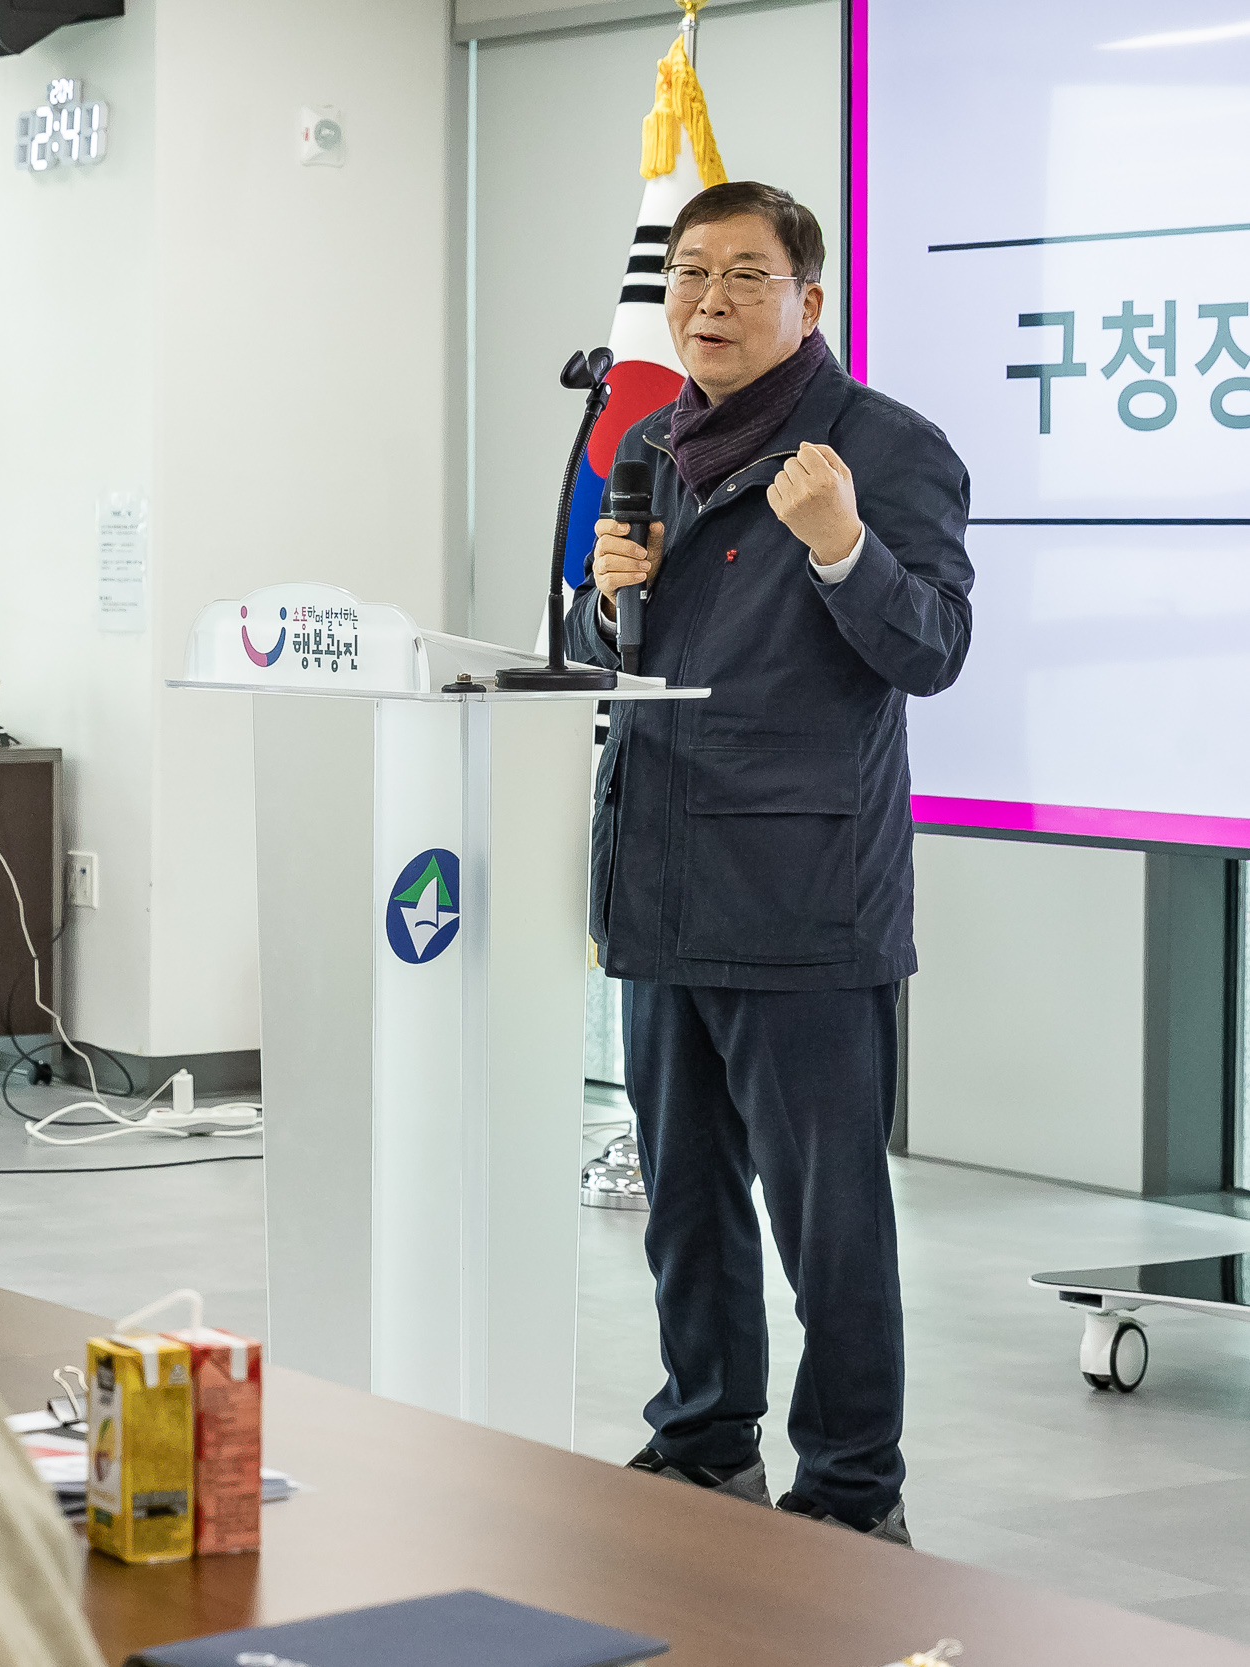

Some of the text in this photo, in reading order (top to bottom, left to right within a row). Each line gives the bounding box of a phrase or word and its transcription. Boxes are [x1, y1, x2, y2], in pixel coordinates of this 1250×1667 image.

[31, 104, 99, 171] 2:41
[293, 605, 358, 631] 소통하며 발전하는
[293, 629, 358, 672] 행복광진
